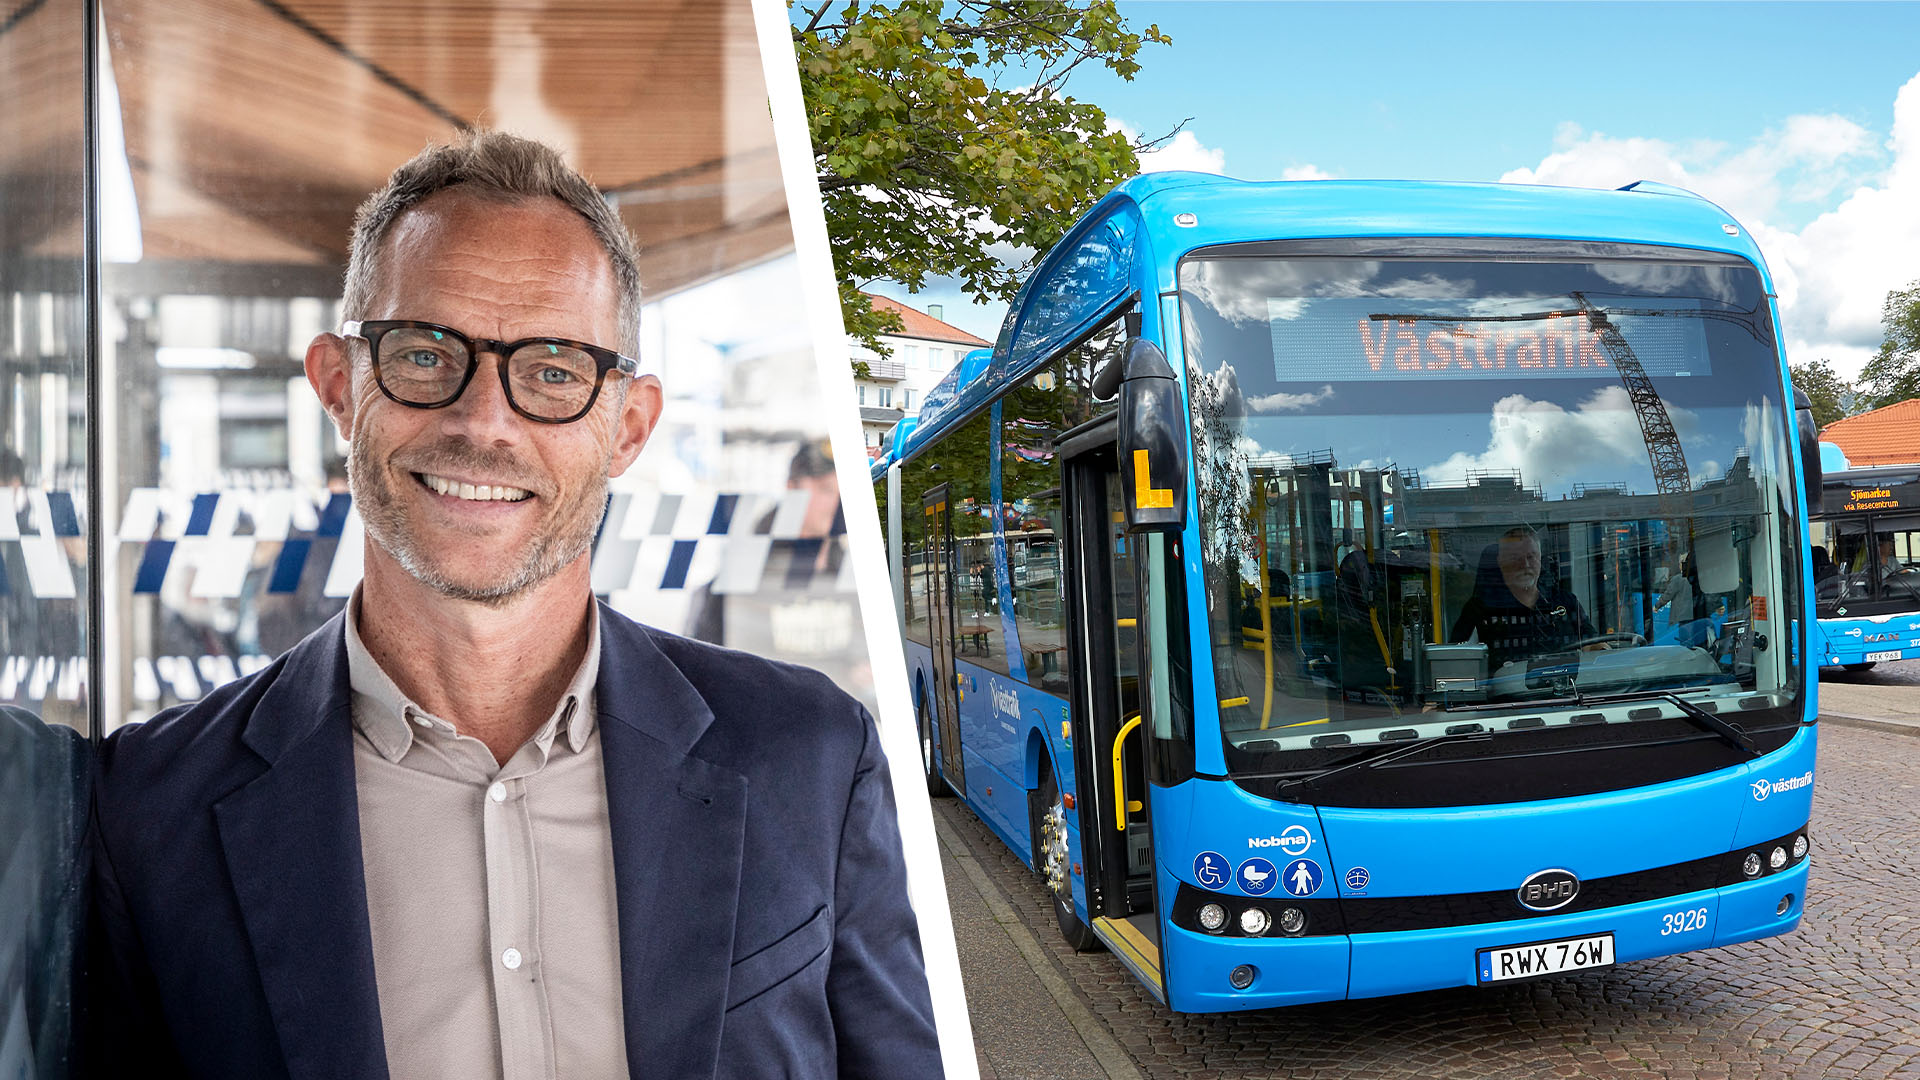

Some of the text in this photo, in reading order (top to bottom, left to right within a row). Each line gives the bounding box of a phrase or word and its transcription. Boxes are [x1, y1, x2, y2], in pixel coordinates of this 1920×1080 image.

[1358, 311, 1608, 371] Västtrafik
[1850, 488, 1891, 502] Sjömarken
[1843, 500, 1899, 511] via Resecentrum
[1864, 632, 1899, 643] MAN
[1869, 653, 1883, 661] YEK
[1772, 771, 1814, 794] västtrafik
[1248, 834, 1306, 848] Nobina
[1526, 880, 1573, 901] BYD
[1660, 908, 1708, 936] 3926
[1500, 940, 1603, 977] RWX 76W
